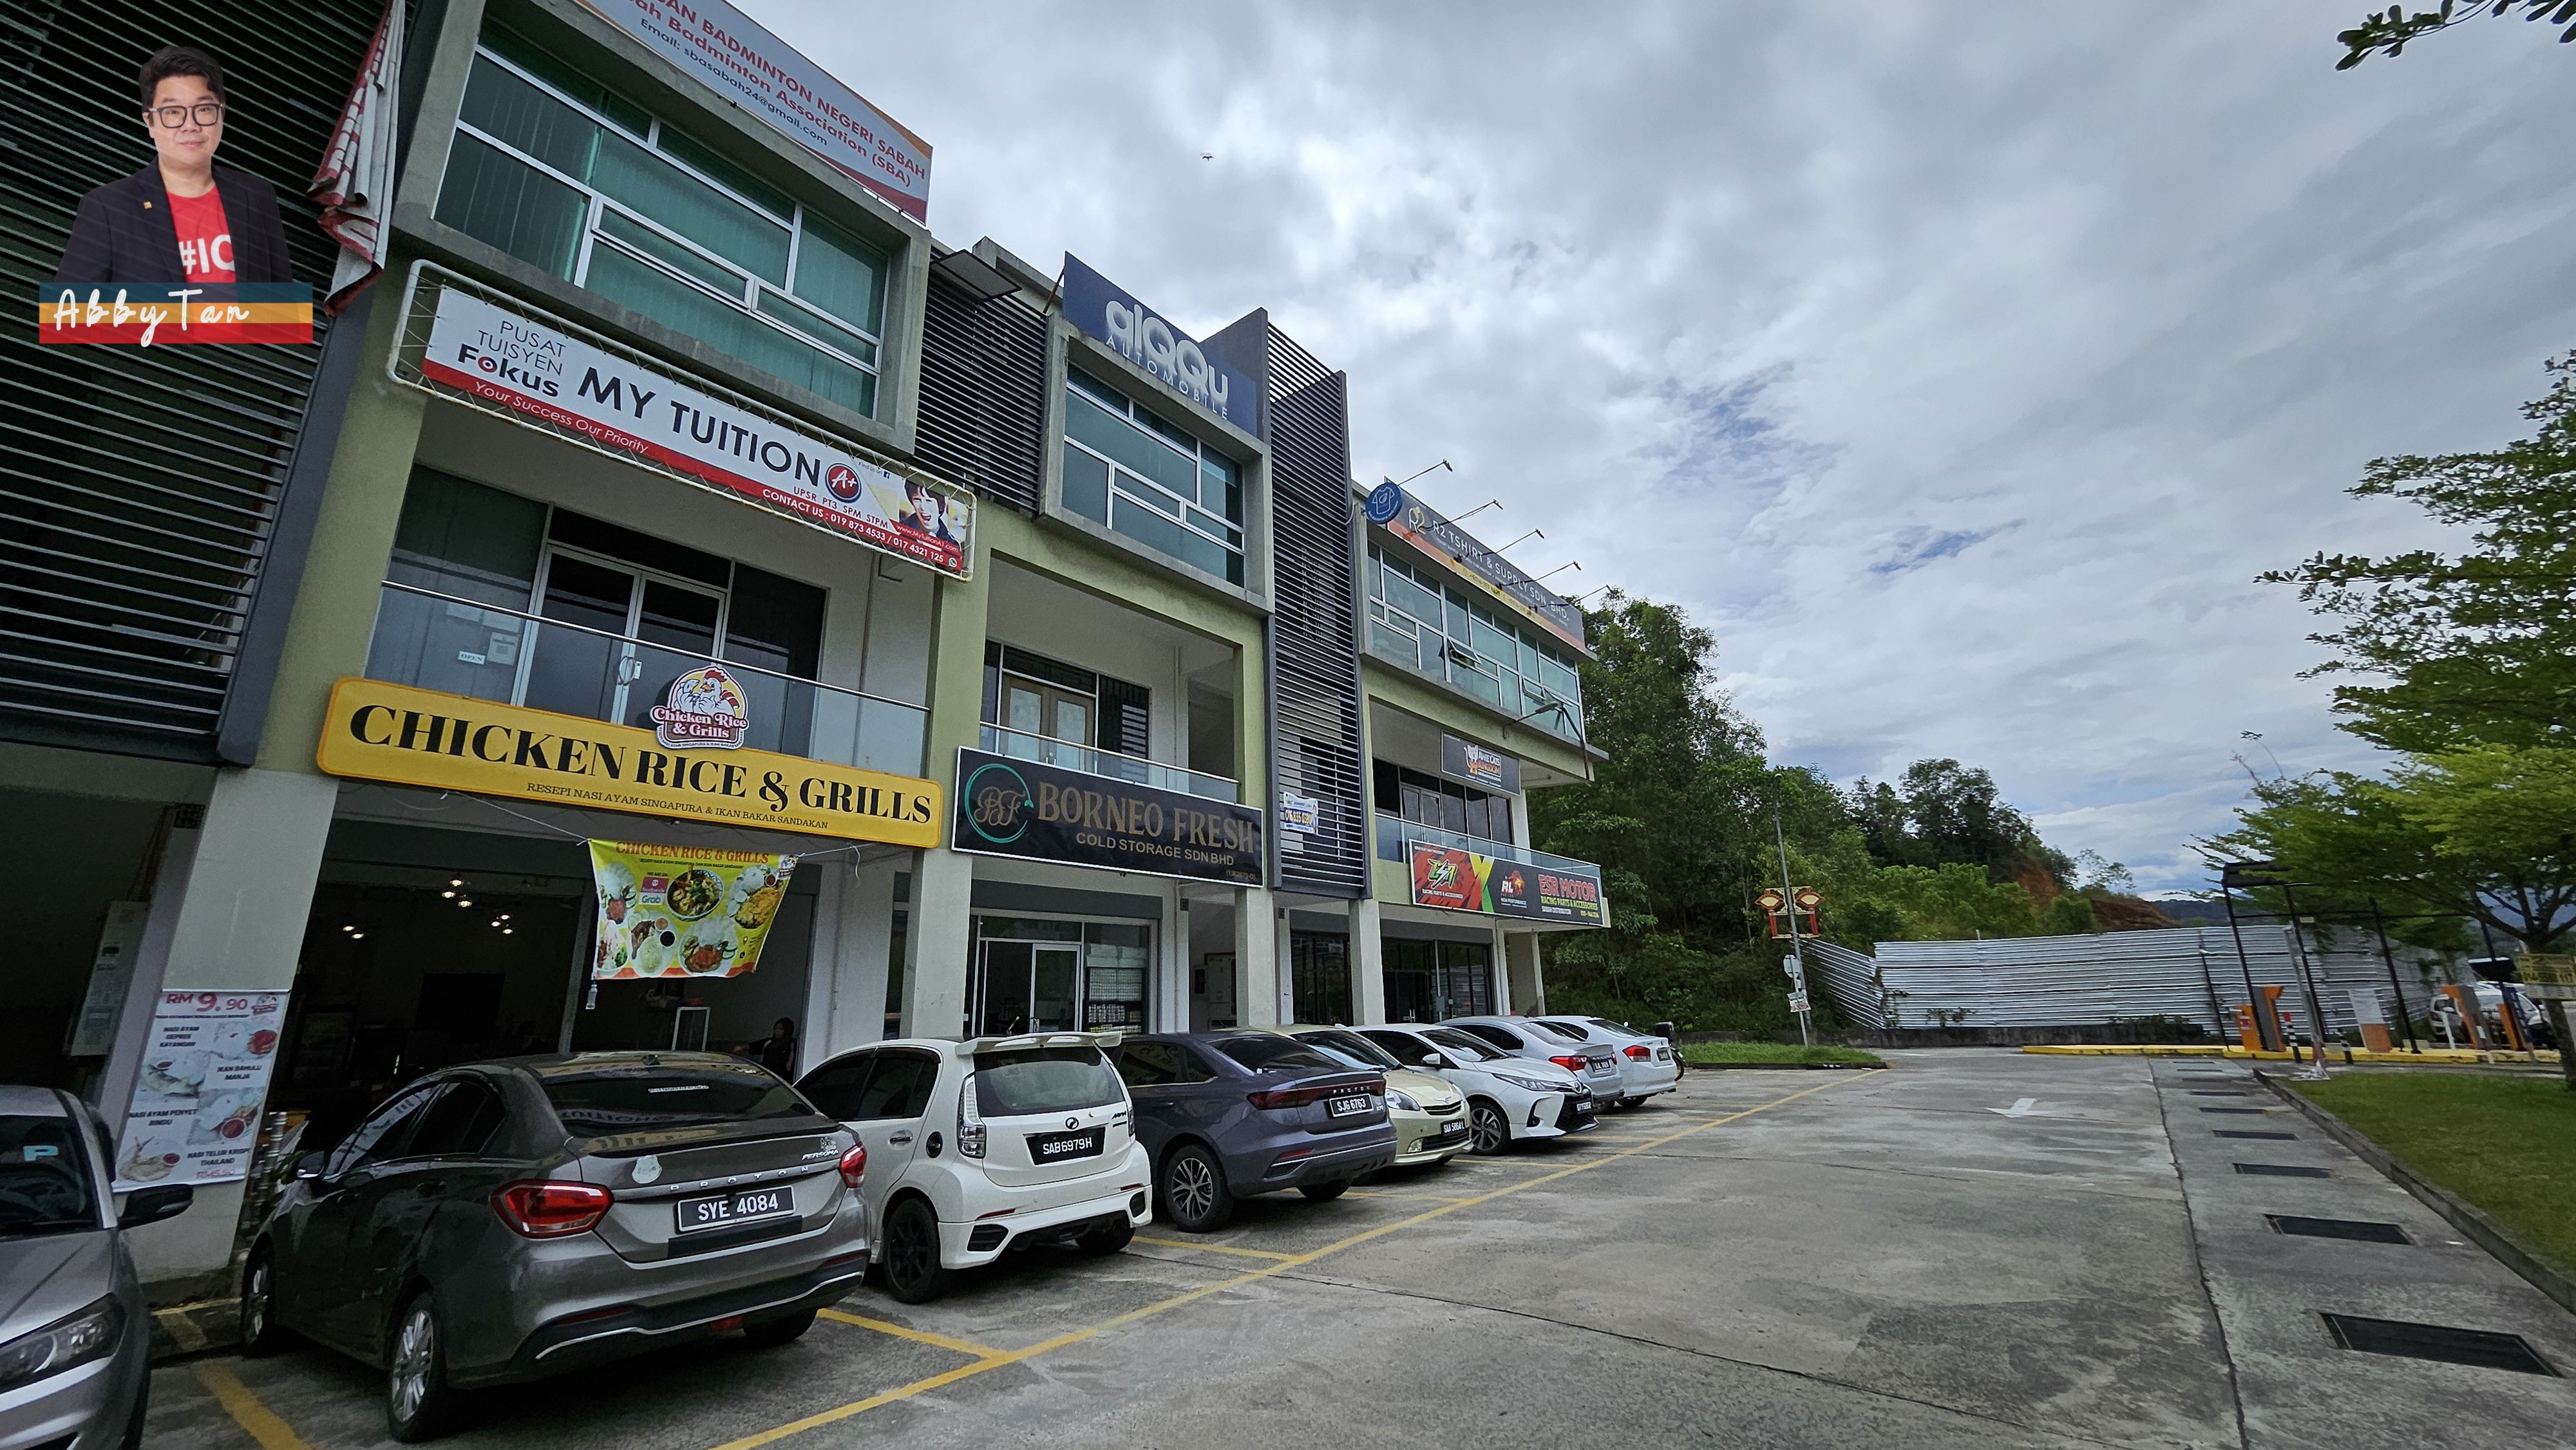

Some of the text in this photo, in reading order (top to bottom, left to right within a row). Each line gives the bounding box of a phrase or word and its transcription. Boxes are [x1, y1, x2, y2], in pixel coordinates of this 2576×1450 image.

[641, 18, 828, 146] Email: sbasabah24@gmail.com
[668, 15, 771, 92] Badminton
[775, 90, 867, 157] Association
[871, 152, 911, 187] (SBA)
[702, 18, 812, 104] BADMINTON
[817, 97, 873, 144] NEGERI
[877, 135, 926, 180] SABAH
[478, 330, 562, 376] TUISYEN
[500, 321, 566, 357] PUSAT
[1106, 335, 1227, 420] AUTOMOBILE
[476, 381, 649, 454] Your Success Our Priority
[578, 366, 820, 486] MY TUITION
[831, 470, 858, 489] A+
[858, 461, 869, 470] Find
[794, 486, 888, 529] UPSR PT3 SPM STPM
[762, 489, 810, 513] CONTACT
[812, 506, 824, 516] US
[831, 514, 847, 526] 019
[848, 520, 864, 533] 873
[866, 528, 886, 540] 4533
[893, 538, 908, 549] 017
[910, 544, 927, 556] 4321
[931, 551, 943, 563] 125
[1433, 520, 1446, 538] R2
[1448, 531, 1482, 562] TSHIRT
[1487, 558, 1492, 569] &
[1495, 563, 1527, 592] SUPPLY
[461, 654, 482, 662] OPEN
[654, 708, 746, 728] Chicken Rice
[672, 722, 729, 738] & Grills
[350, 704, 931, 824] CHICKEN RICE & GRILLS
[527, 783, 828, 829] RESEPI NASI AYAM SINGAPURA & IKAN BAKAR SANDAKAN
[1037, 782, 1253, 853] BORNEO FRESH
[616, 842, 769, 864] CHICKEN RICE & GRILLS
[1076, 832, 1234, 865] COLD STORAGE SDN BHD
[641, 894, 661, 903] Grab
[1539, 874, 1596, 901] ESR MOTOR
[1540, 896, 1557, 905] RACING
[1557, 898, 1570, 907] PARTS
[166, 993, 193, 1004] RM
[1333, 1086, 1370, 1094] PROTON
[1337, 1098, 1365, 1111] SJG 6763
[23, 1145, 59, 1162] P
[802, 1149, 838, 1160] PERSONA
[670, 1166, 809, 1191] PROTON
[698, 1193, 779, 1221] SYE 4084
